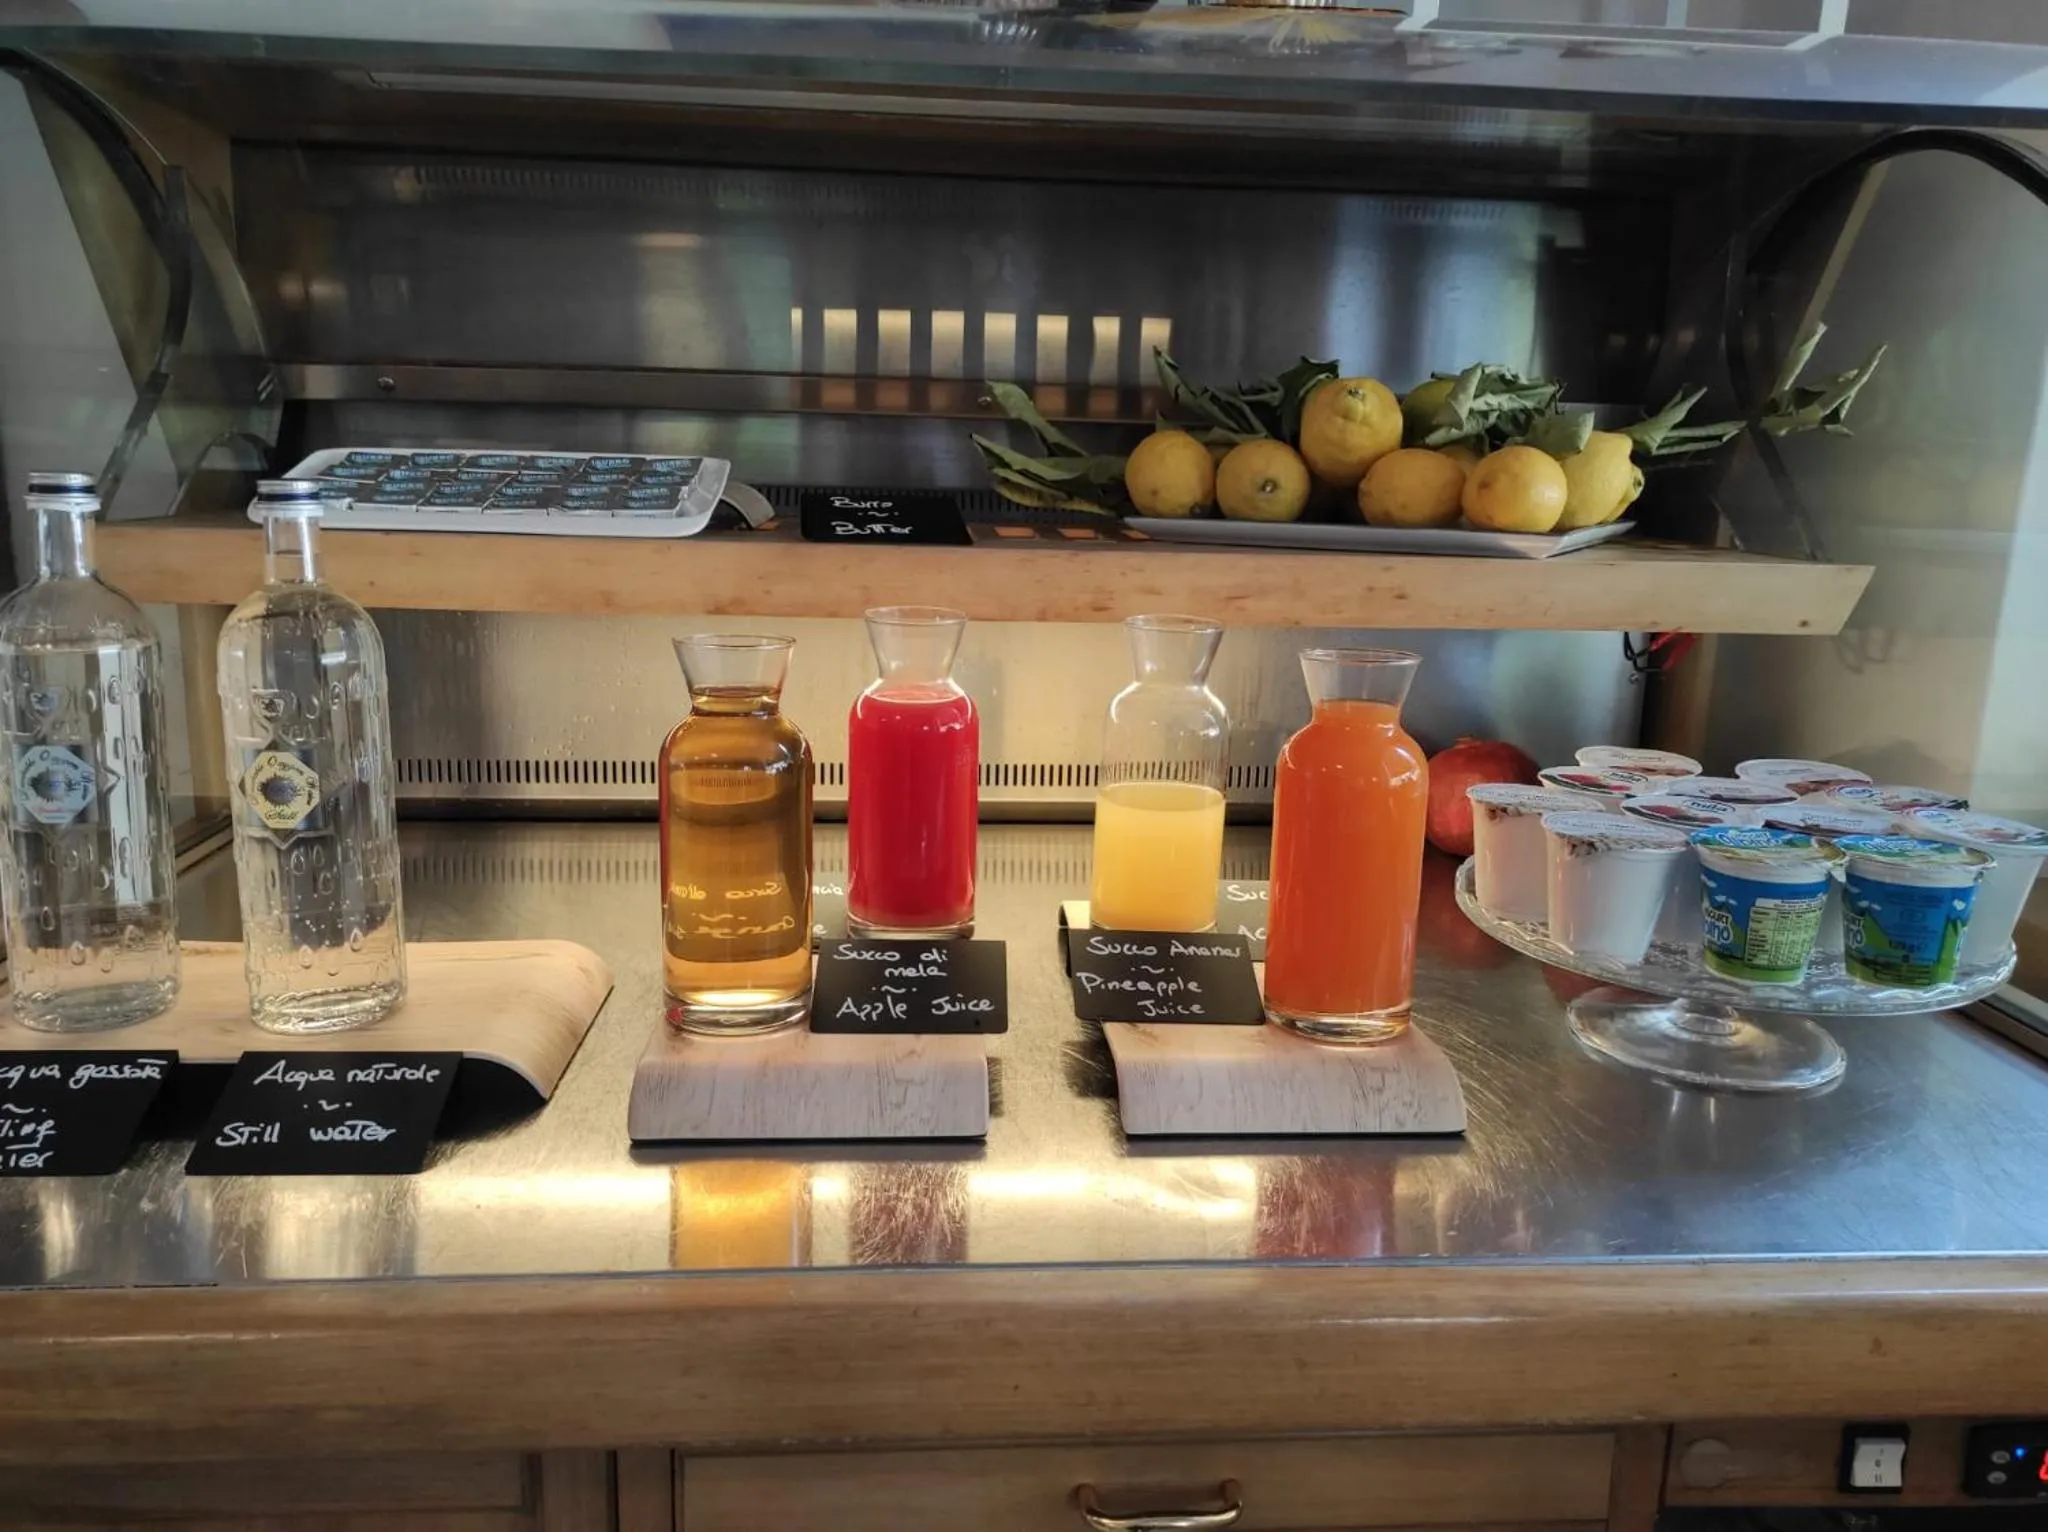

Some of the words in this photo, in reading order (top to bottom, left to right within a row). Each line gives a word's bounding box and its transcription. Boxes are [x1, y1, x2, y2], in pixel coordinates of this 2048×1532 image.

[829, 496, 894, 509] Burro
[830, 521, 914, 536] Butter
[833, 944, 900, 962] Succo
[919, 945, 948, 962] di
[1086, 936, 1158, 956] Succo
[1169, 940, 1242, 959] Ananas
[884, 963, 947, 978] mela
[1076, 972, 1203, 997] Pineapple
[835, 996, 907, 1020] Apple
[930, 998, 995, 1016] Juice
[1137, 1000, 1206, 1017] Juice
[69, 1058, 169, 1089] gassata
[253, 1059, 336, 1090] Acqua
[347, 1063, 441, 1083] naturale
[215, 1121, 280, 1147] Still
[309, 1120, 397, 1142] water
